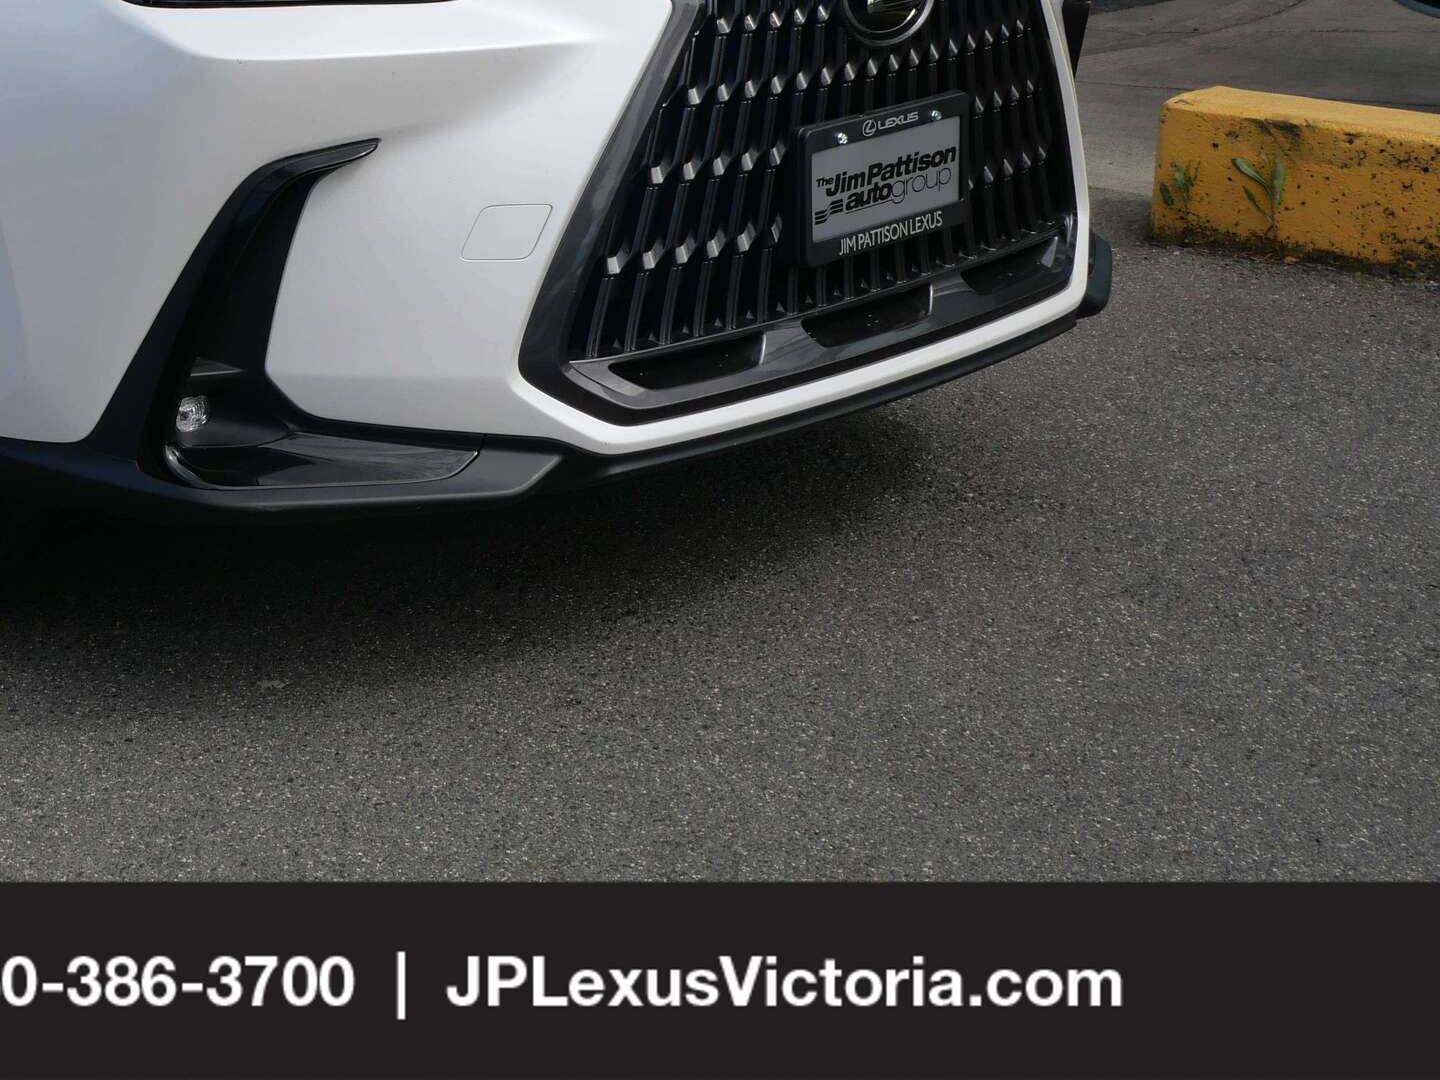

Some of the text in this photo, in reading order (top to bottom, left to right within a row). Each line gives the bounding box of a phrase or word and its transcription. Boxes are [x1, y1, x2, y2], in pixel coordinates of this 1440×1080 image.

[877, 111, 919, 130] LEXUS
[816, 146, 957, 197] The Jim Pattison
[839, 211, 943, 256] JIM PATTISON LEXUS
